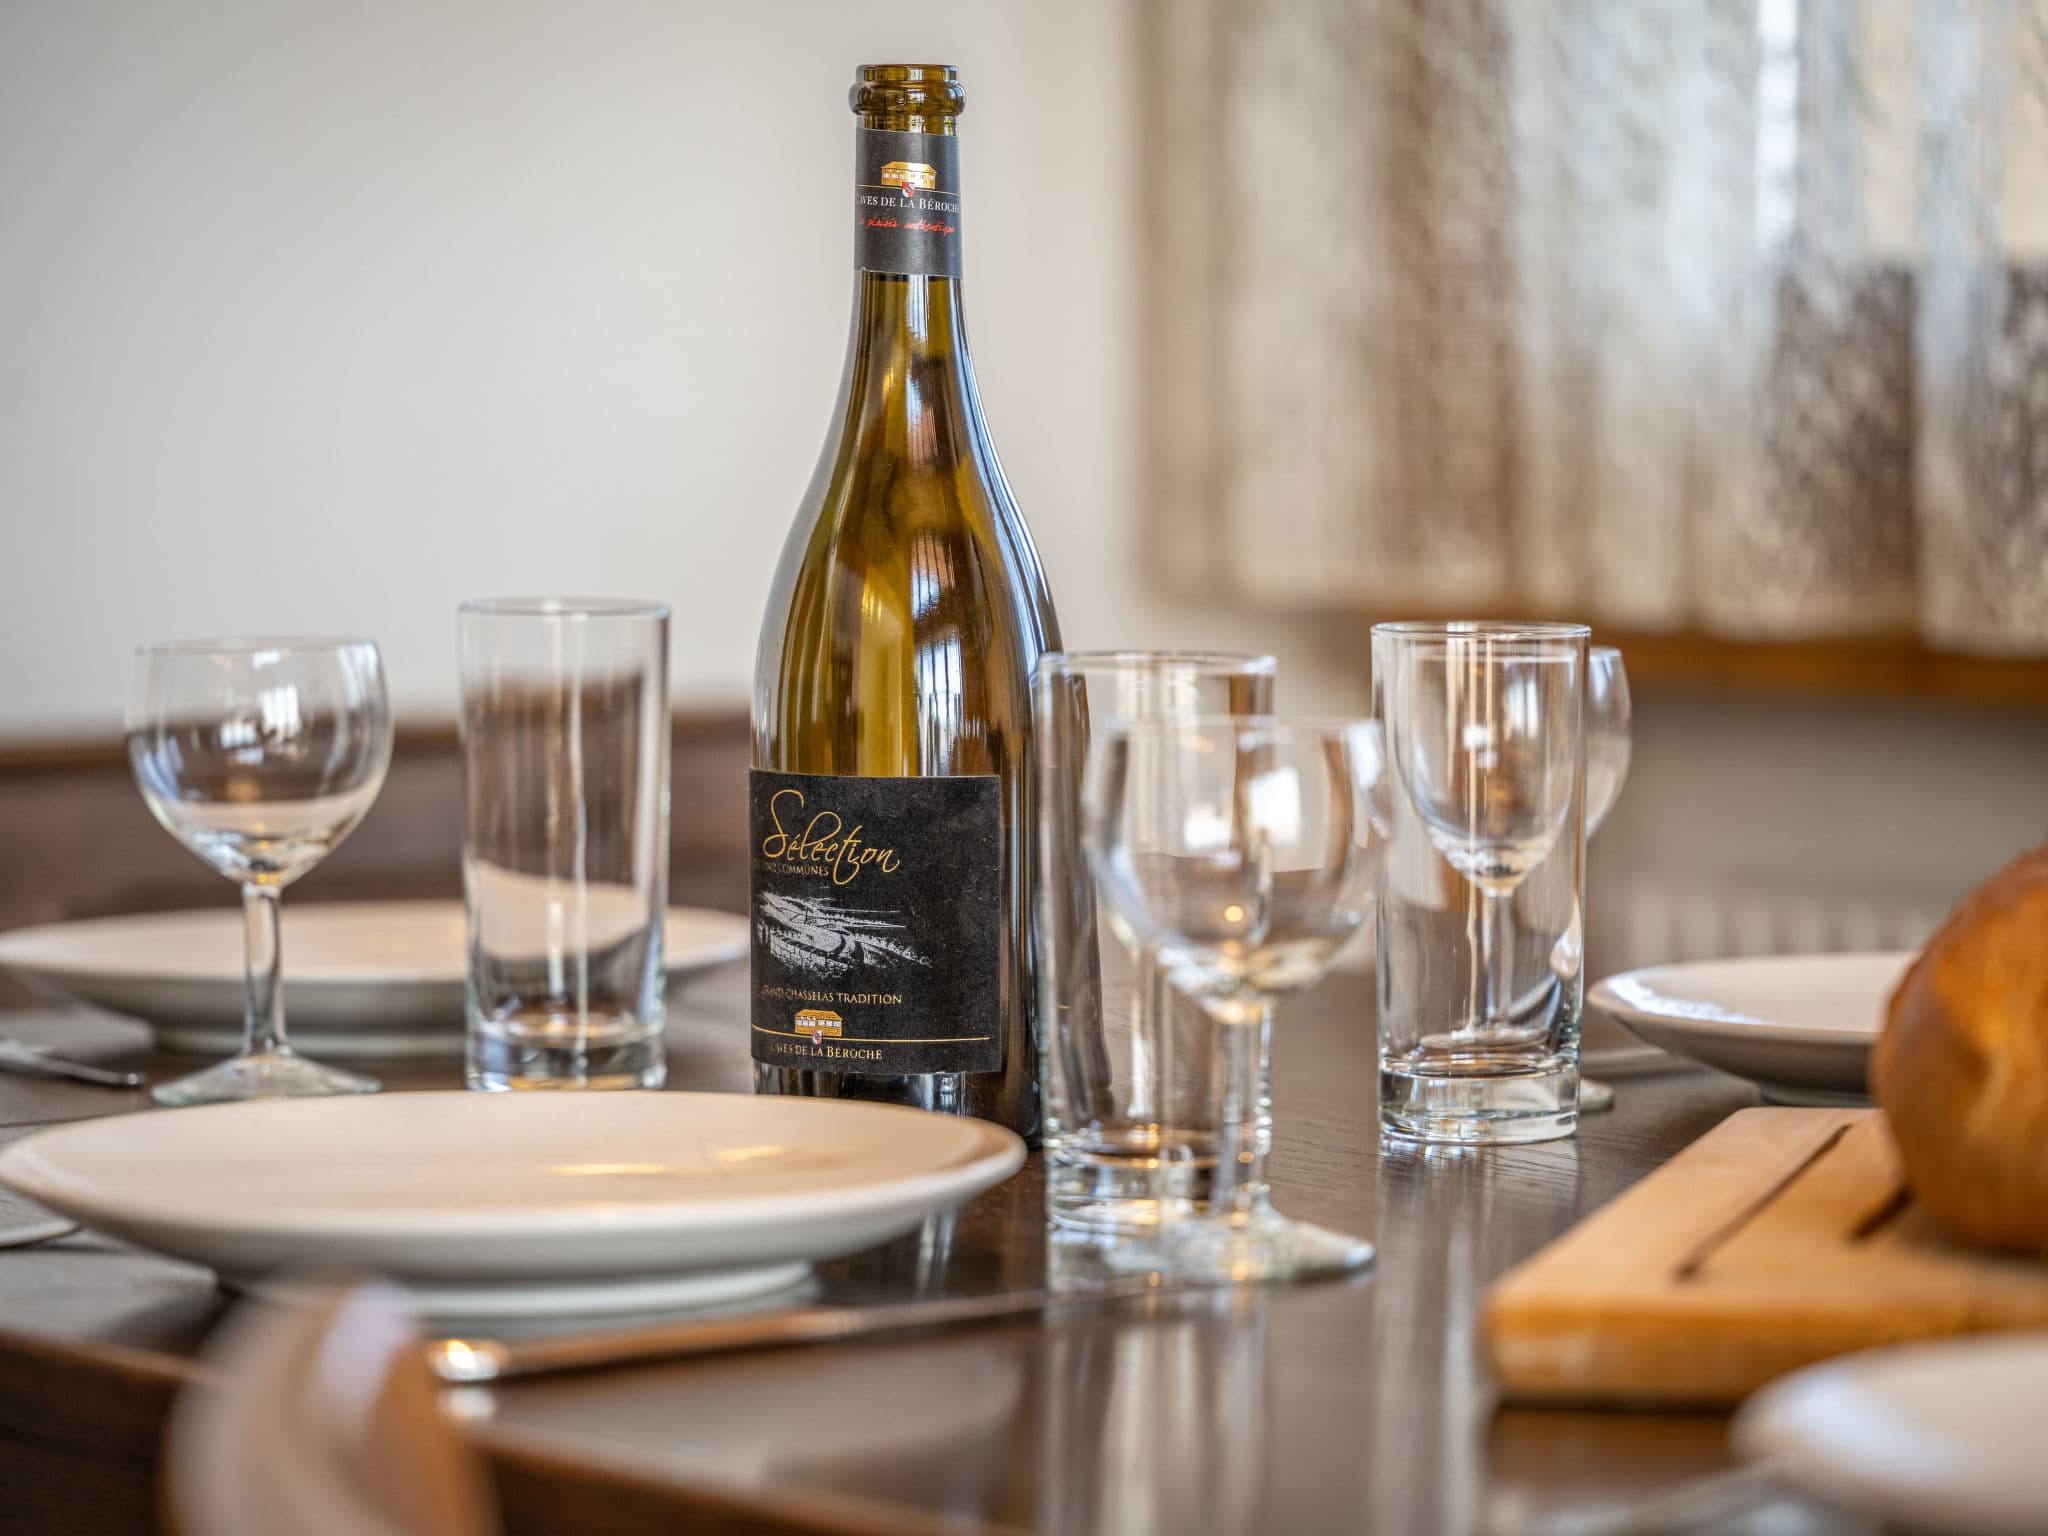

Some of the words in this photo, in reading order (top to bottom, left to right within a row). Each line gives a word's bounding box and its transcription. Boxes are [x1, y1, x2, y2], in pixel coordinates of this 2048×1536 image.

[881, 196, 896, 207] DE
[900, 198, 915, 209] LA
[763, 789, 900, 885] Sélection
[785, 988, 834, 1002] CHASSELAS
[837, 992, 903, 1005] TRADITION
[795, 1045, 808, 1056] DE
[811, 1047, 824, 1058] LA
[827, 1045, 883, 1060] BÉROCHE
